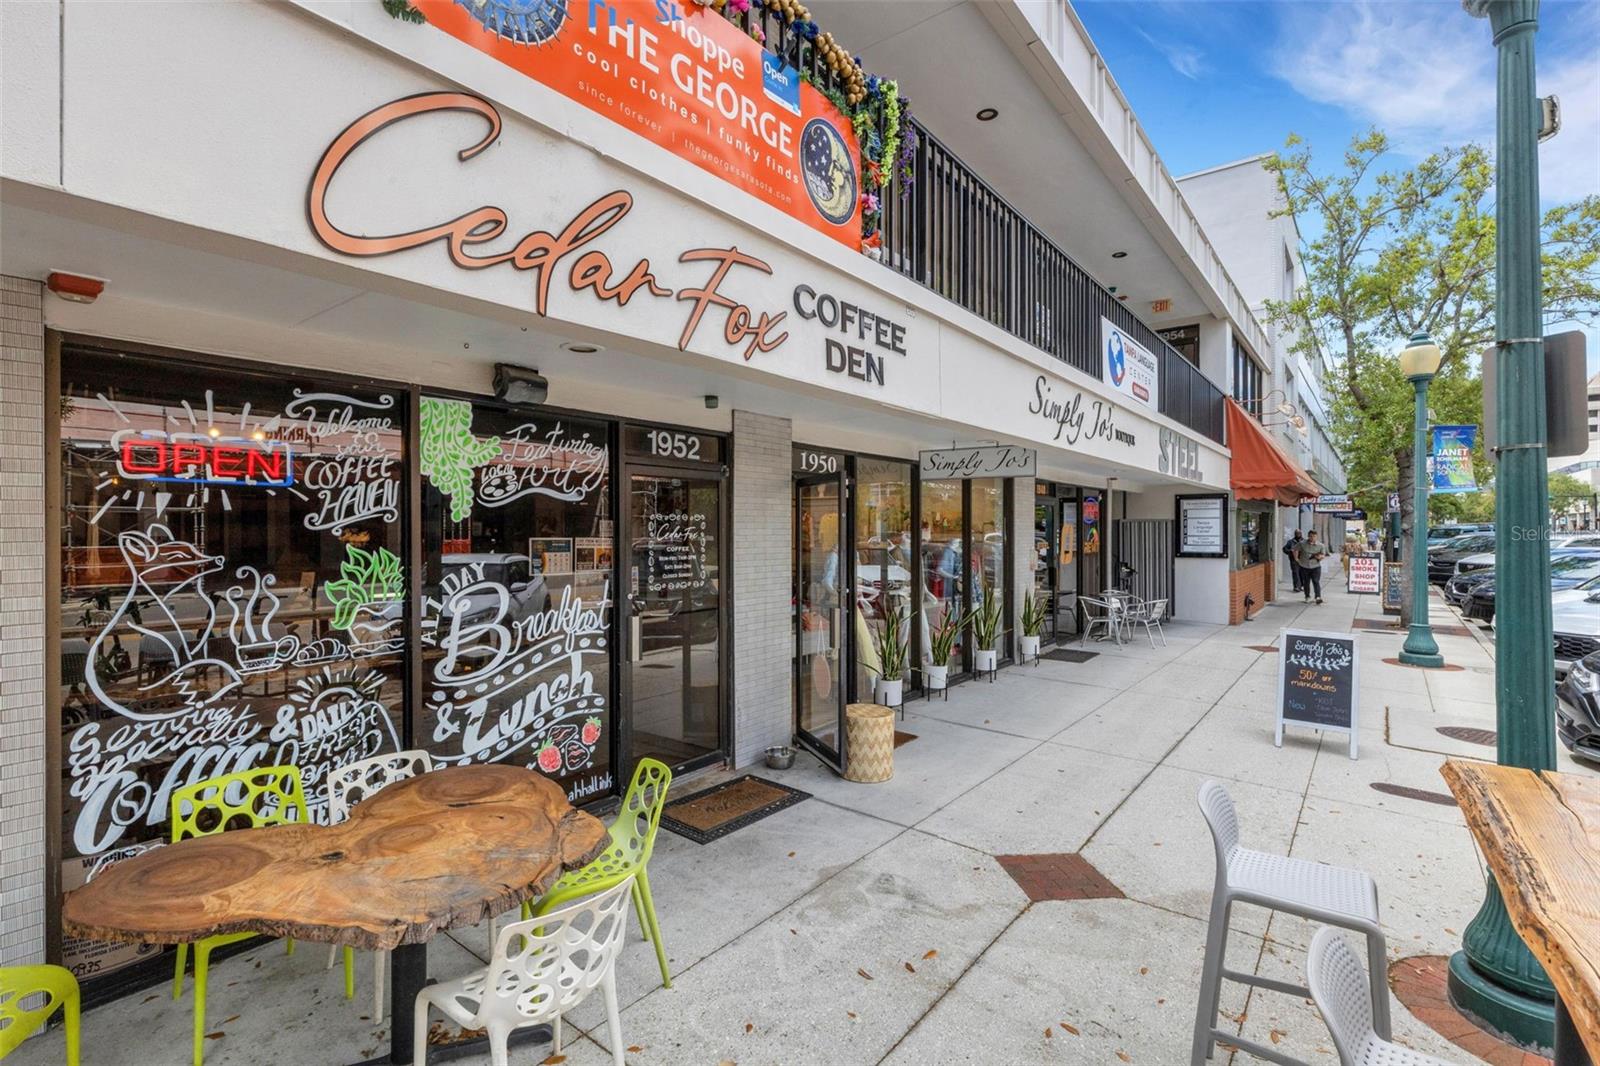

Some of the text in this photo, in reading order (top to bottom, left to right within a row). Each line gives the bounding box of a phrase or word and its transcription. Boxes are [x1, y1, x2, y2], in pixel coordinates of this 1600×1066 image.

[656, 0, 745, 80] Shoppe
[588, 0, 793, 159] THE GEORGE
[763, 61, 789, 86] Open
[573, 43, 799, 185] cool clothes funky finds
[578, 80, 613, 106] since
[619, 101, 662, 134] forever
[306, 91, 788, 361] Cedar Fox
[793, 284, 907, 357] COFFEE
[1160, 329, 1185, 341] 954
[825, 337, 885, 386] DEN
[302, 405, 393, 438] Welcome
[1028, 375, 1085, 445] Simply
[1085, 400, 1114, 442] Jo's
[121, 440, 281, 479] OPEN
[351, 430, 379, 445] to
[503, 421, 609, 468] Featuring
[647, 430, 700, 460] 1952
[1158, 425, 1204, 481] STEEL
[1436, 448, 1469, 457] JANET
[517, 460, 577, 493] Art
[799, 452, 838, 474] 1950
[923, 449, 983, 477] Simply
[984, 447, 1030, 473] Jo's
[317, 478, 400, 525] HAVEN
[656, 523, 683, 541] Cedar
[439, 561, 486, 598] DAY
[434, 579, 612, 682] Breakfast
[1295, 640, 1324, 657] Simply
[433, 653, 594, 755] & Lunch
[1290, 680, 1337, 693] markdowns
[70, 704, 236, 753] Serving
[270, 704, 299, 742] &
[300, 698, 365, 742] DAILY
